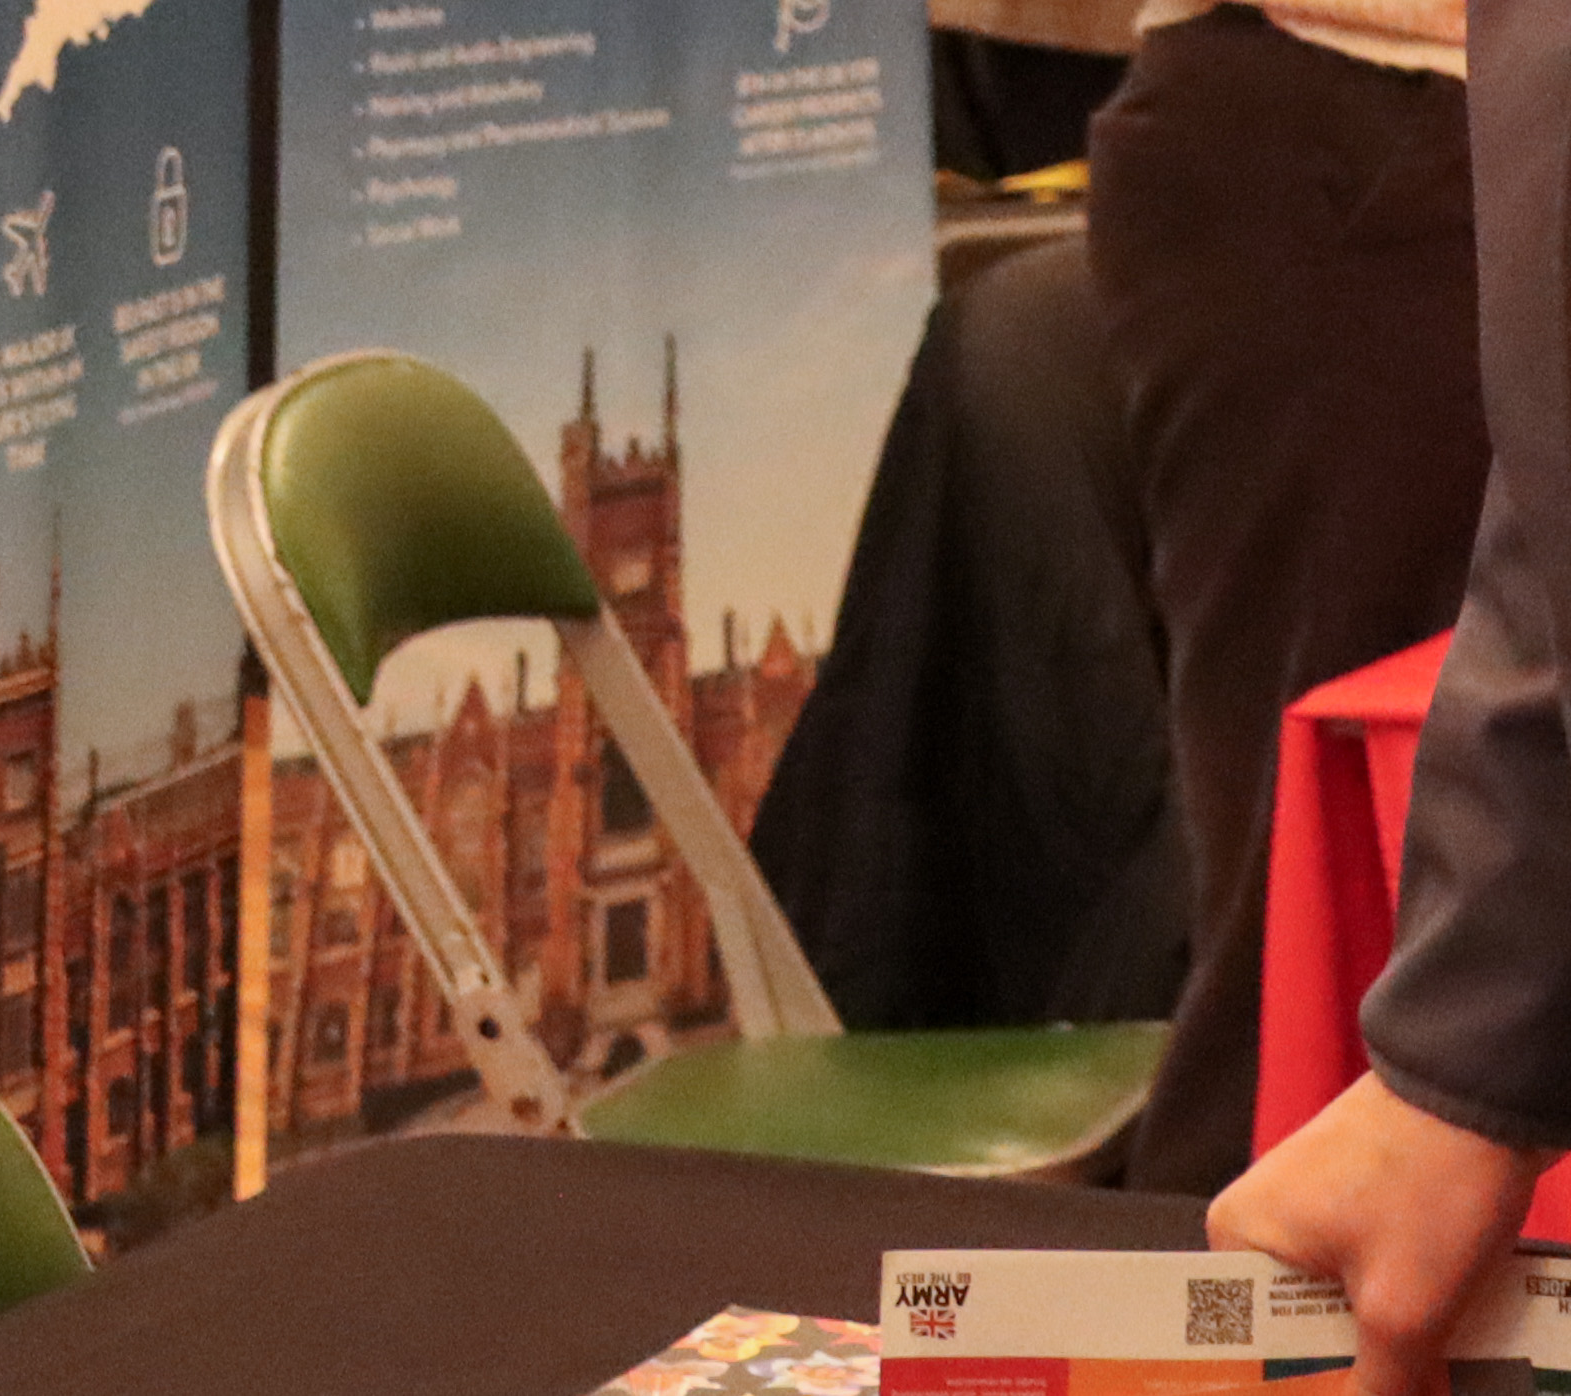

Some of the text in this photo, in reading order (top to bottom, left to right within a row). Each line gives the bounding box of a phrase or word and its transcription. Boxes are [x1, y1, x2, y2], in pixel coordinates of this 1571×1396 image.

[896, 1272, 926, 1285] BEST
[929, 1272, 952, 1285] THE
[1527, 1276, 1570, 1295] JOBS
[895, 1285, 972, 1308] ARMY
